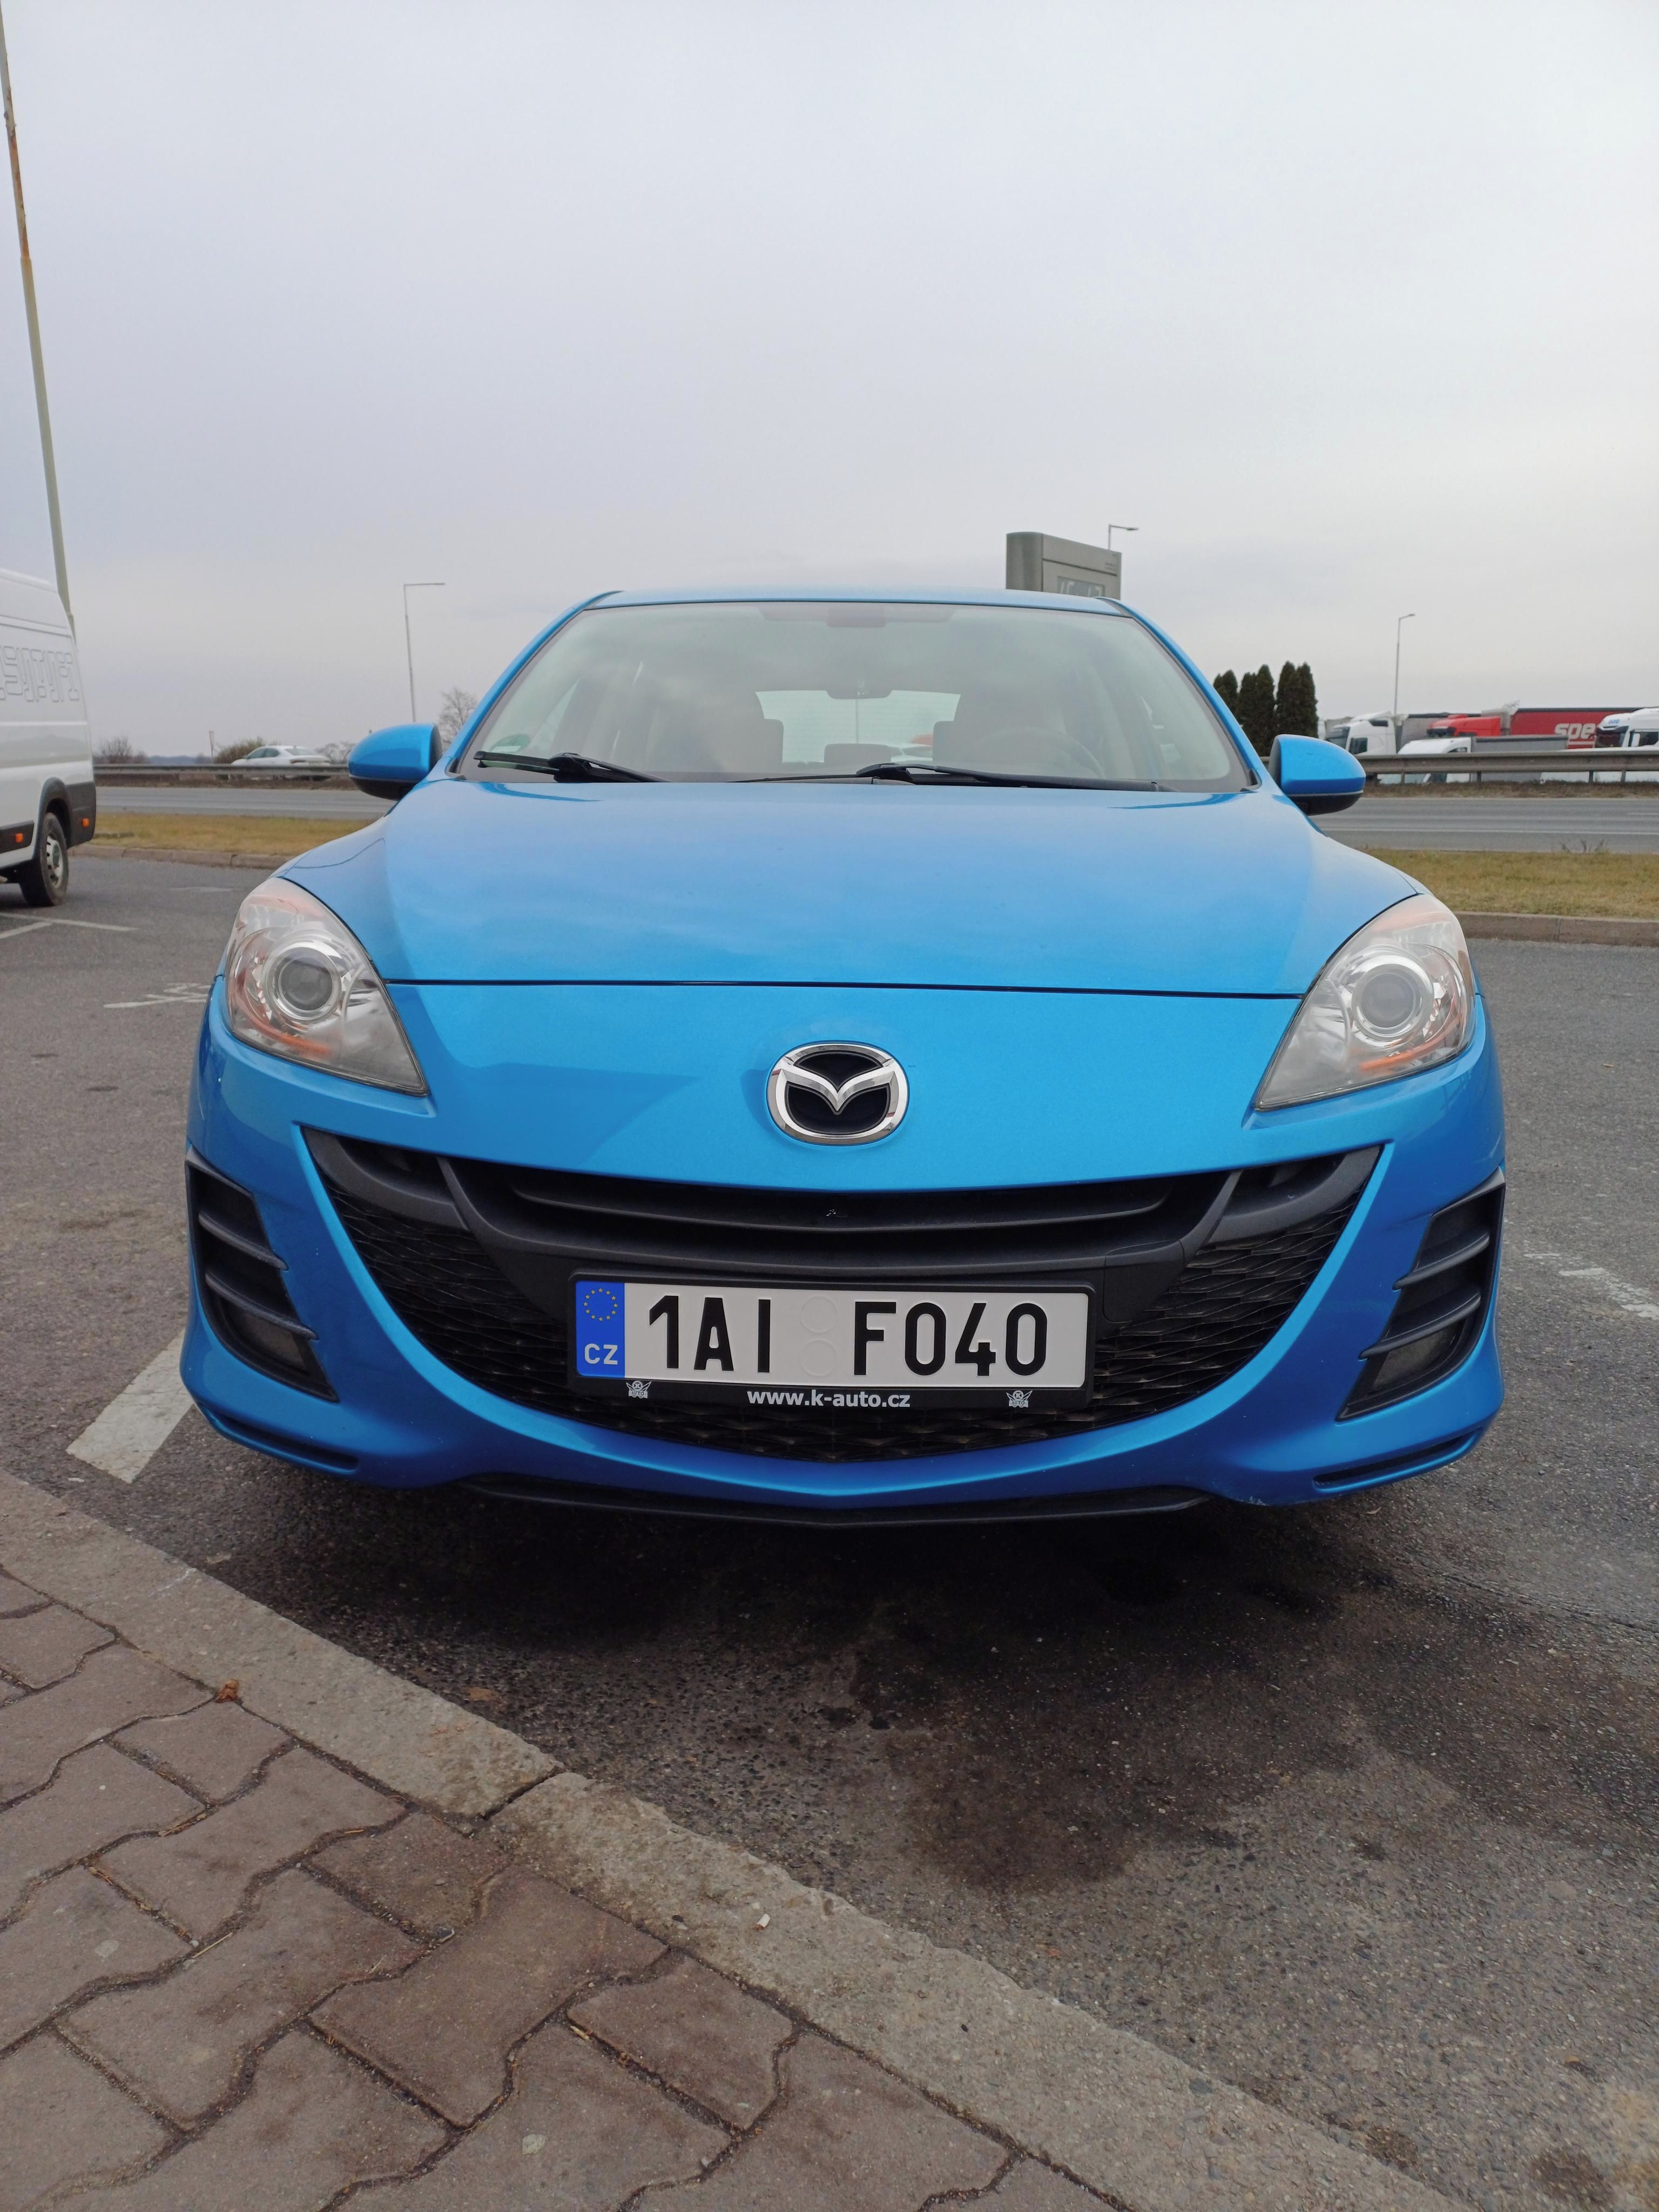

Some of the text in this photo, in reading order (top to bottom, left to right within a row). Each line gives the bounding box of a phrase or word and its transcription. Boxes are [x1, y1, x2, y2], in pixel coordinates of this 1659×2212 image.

[649, 1295, 1048, 1377] 1AI F040
[584, 1343, 618, 1365] CZ
[747, 1389, 911, 1407] www.k-auto.cz
